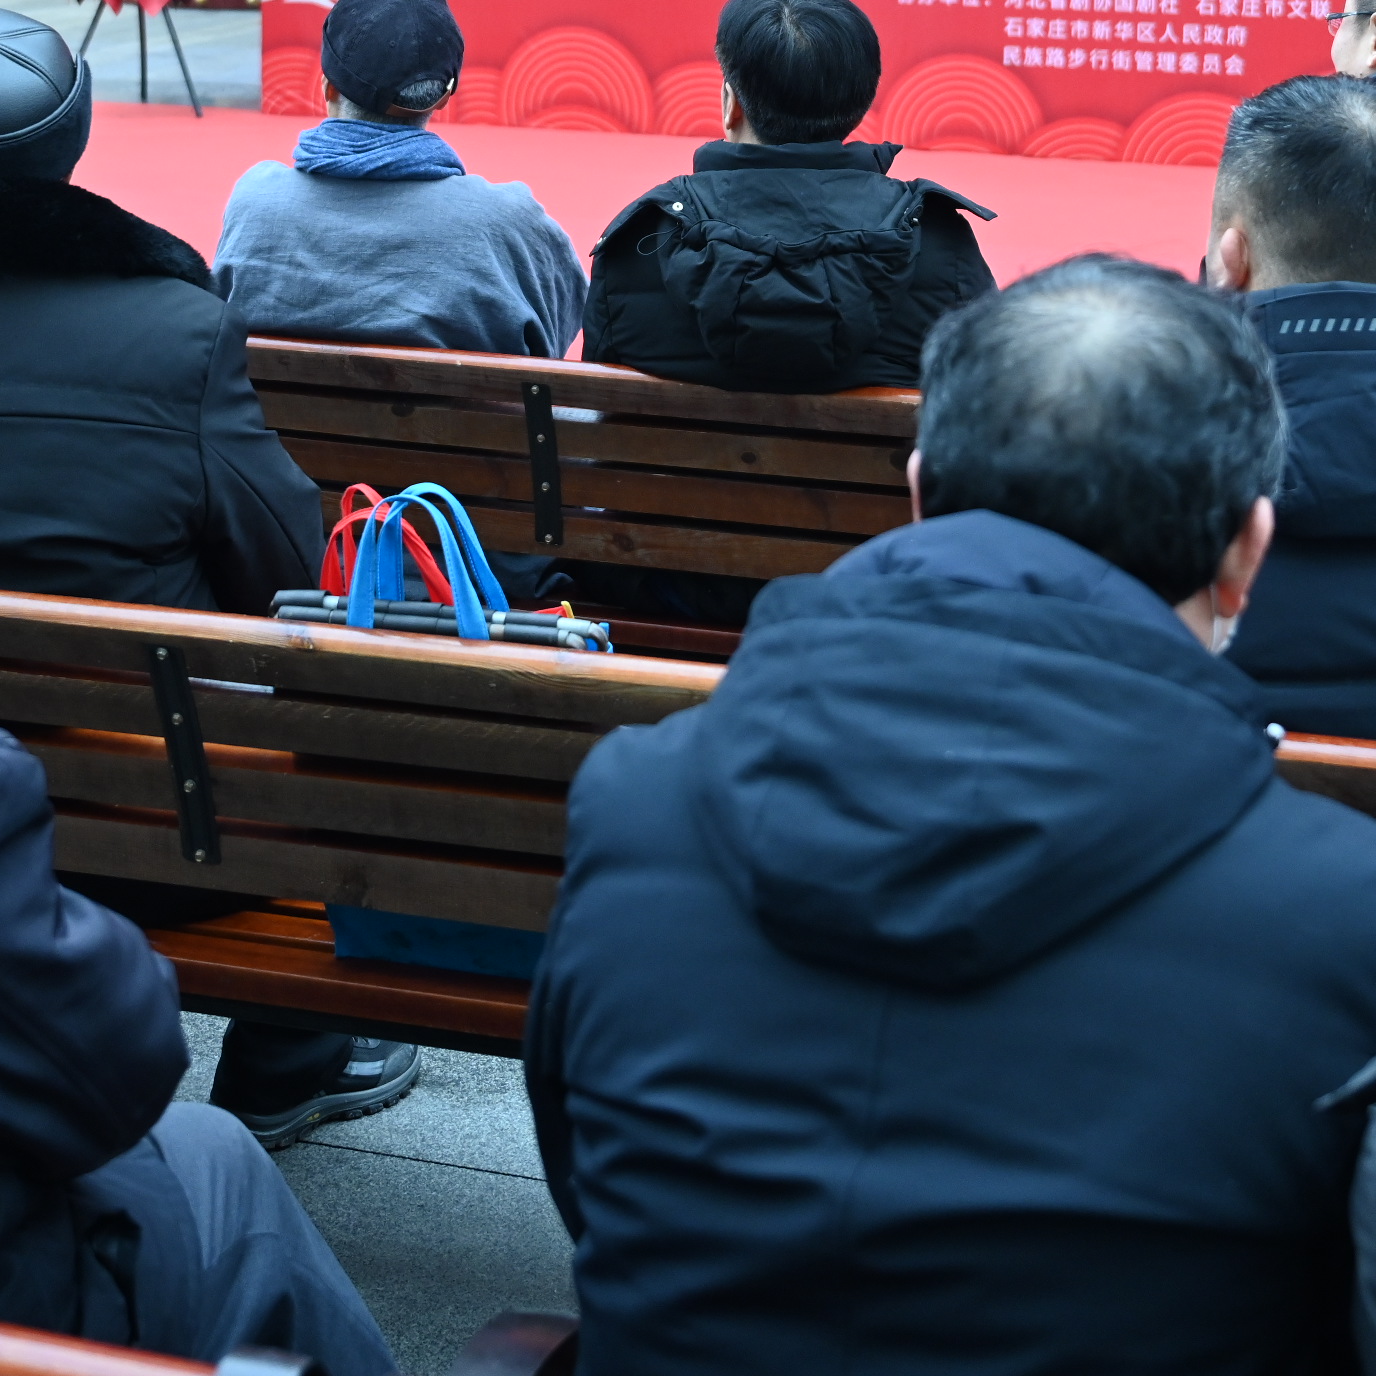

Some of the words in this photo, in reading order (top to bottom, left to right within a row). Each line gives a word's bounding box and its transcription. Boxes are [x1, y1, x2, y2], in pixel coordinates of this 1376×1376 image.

[1003, 17, 1249, 48] 石家庄市新华区人民政府
[1002, 45, 1246, 77] 民族路步行街管理委员会
